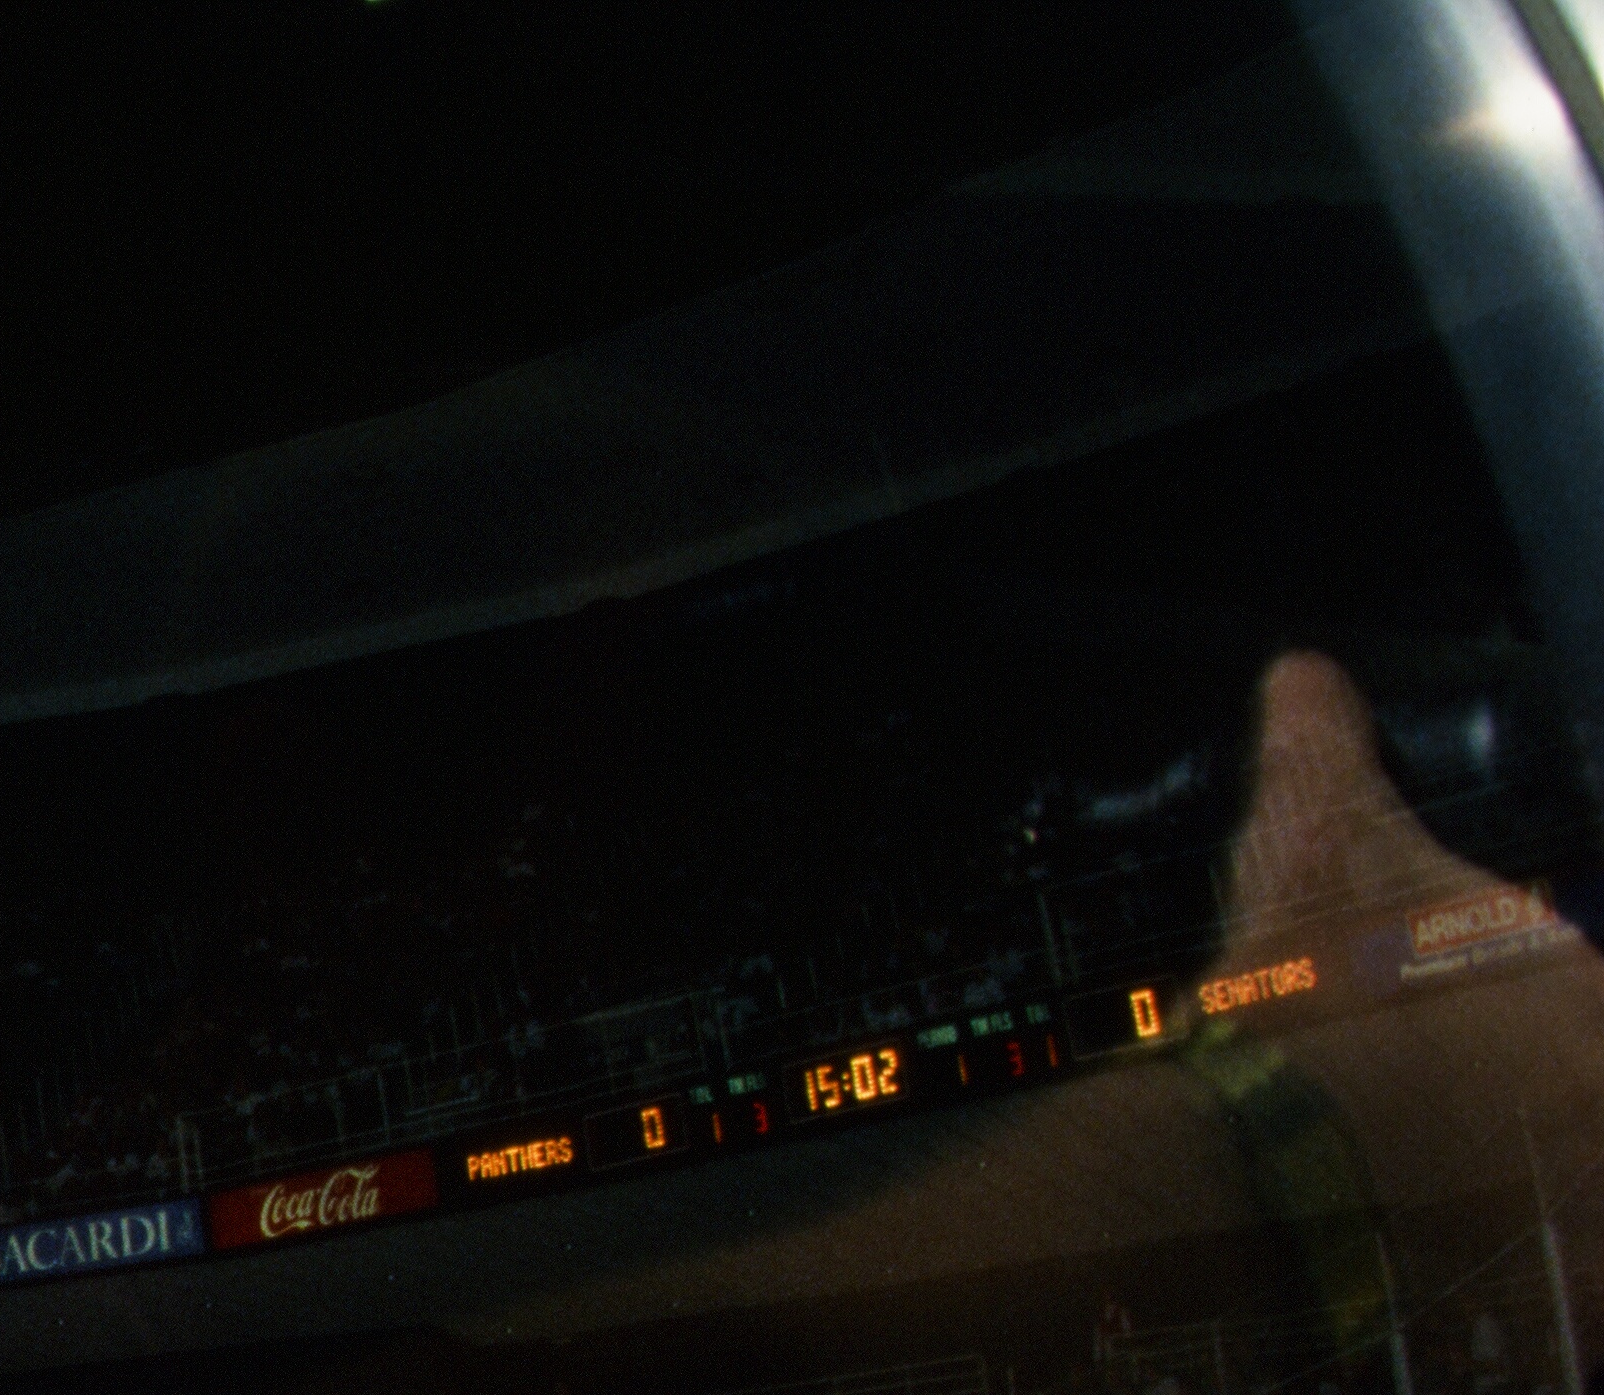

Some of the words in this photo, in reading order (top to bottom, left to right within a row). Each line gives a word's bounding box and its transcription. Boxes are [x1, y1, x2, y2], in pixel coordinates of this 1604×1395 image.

[1415, 897, 1518, 949] ARNOLD
[1199, 956, 1318, 1015] SENATORS
[1130, 988, 1162, 1038] 0
[805, 1047, 899, 1112] 15:02
[640, 1107, 666, 1149] 0
[466, 1137, 574, 1182] PANTHERS
[259, 1163, 381, 1239] Coca-Cola
